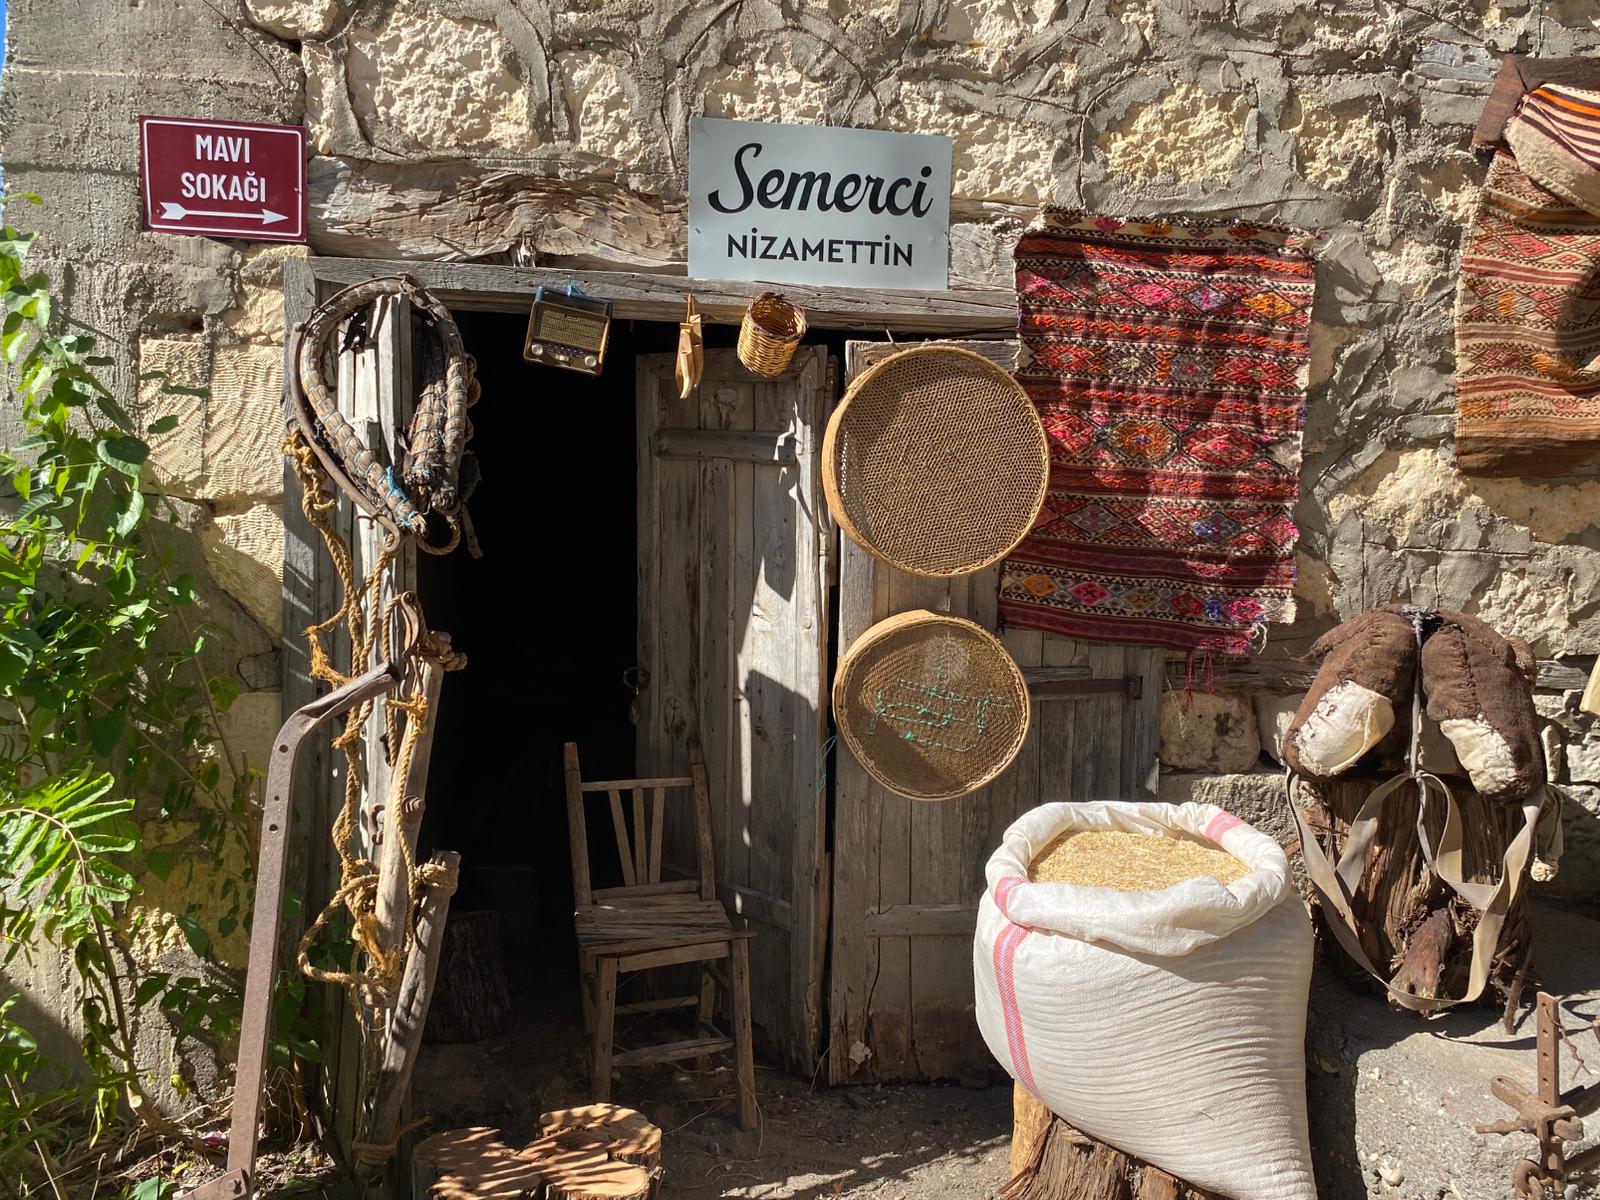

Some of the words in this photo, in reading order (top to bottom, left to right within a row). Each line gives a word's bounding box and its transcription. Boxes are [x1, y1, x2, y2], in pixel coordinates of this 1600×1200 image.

[195, 134, 250, 164] MAVI
[181, 171, 266, 203] SOKAĞI
[708, 142, 934, 218] Semerci
[727, 227, 913, 267] NİZAMETTİN
